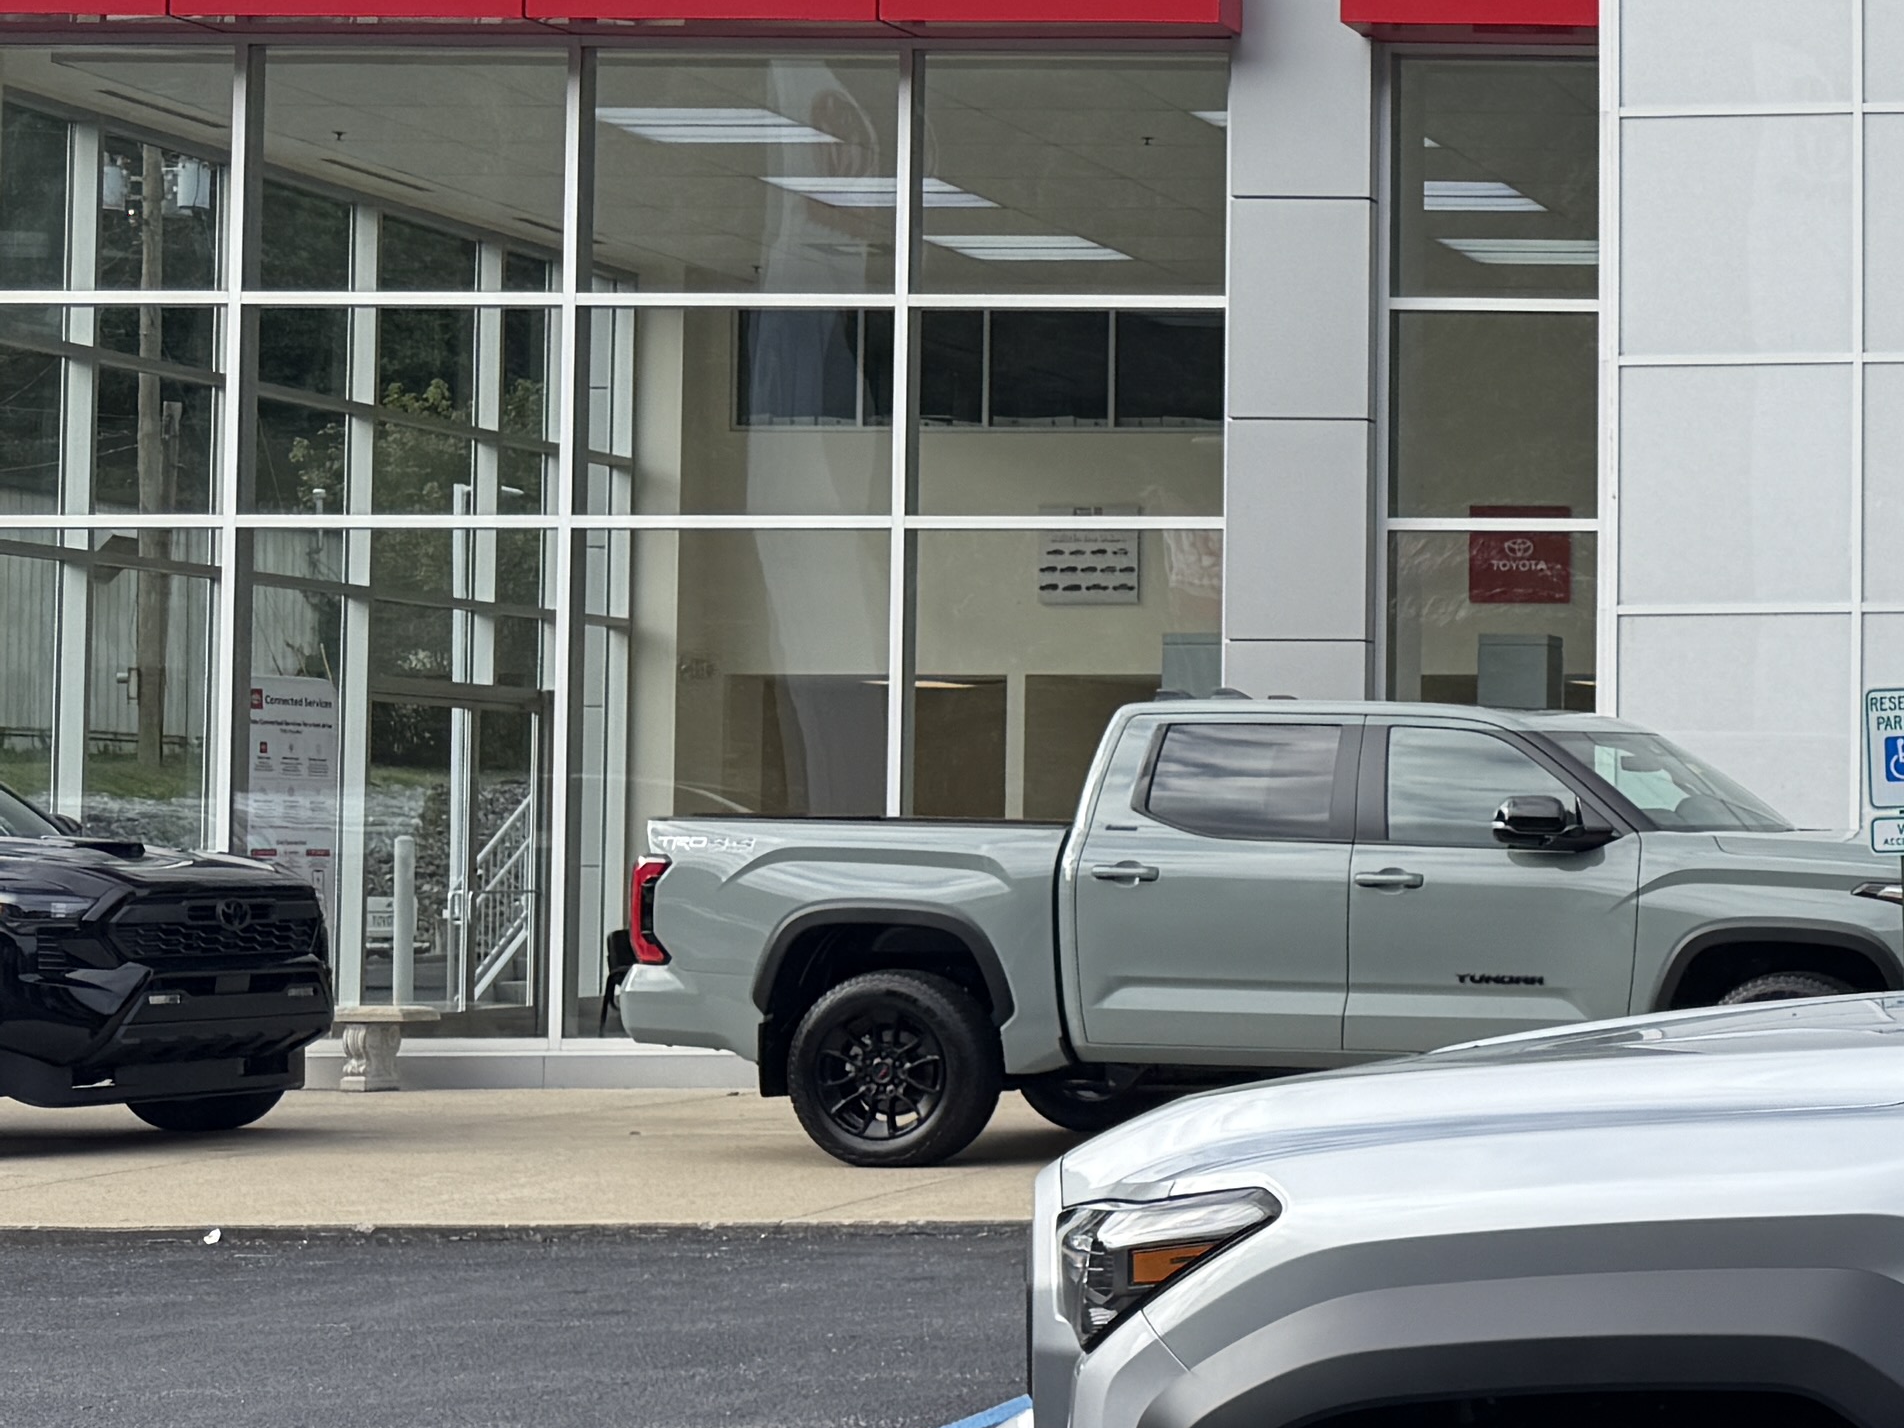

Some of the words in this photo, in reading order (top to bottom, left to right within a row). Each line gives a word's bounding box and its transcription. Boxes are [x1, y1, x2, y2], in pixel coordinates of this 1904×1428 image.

[1491, 560, 1547, 571] TOYOTA
[264, 694, 303, 707] Connected
[304, 698, 333, 709] Services
[658, 835, 708, 851] TRD
[1456, 973, 1544, 985] TUNDRA
